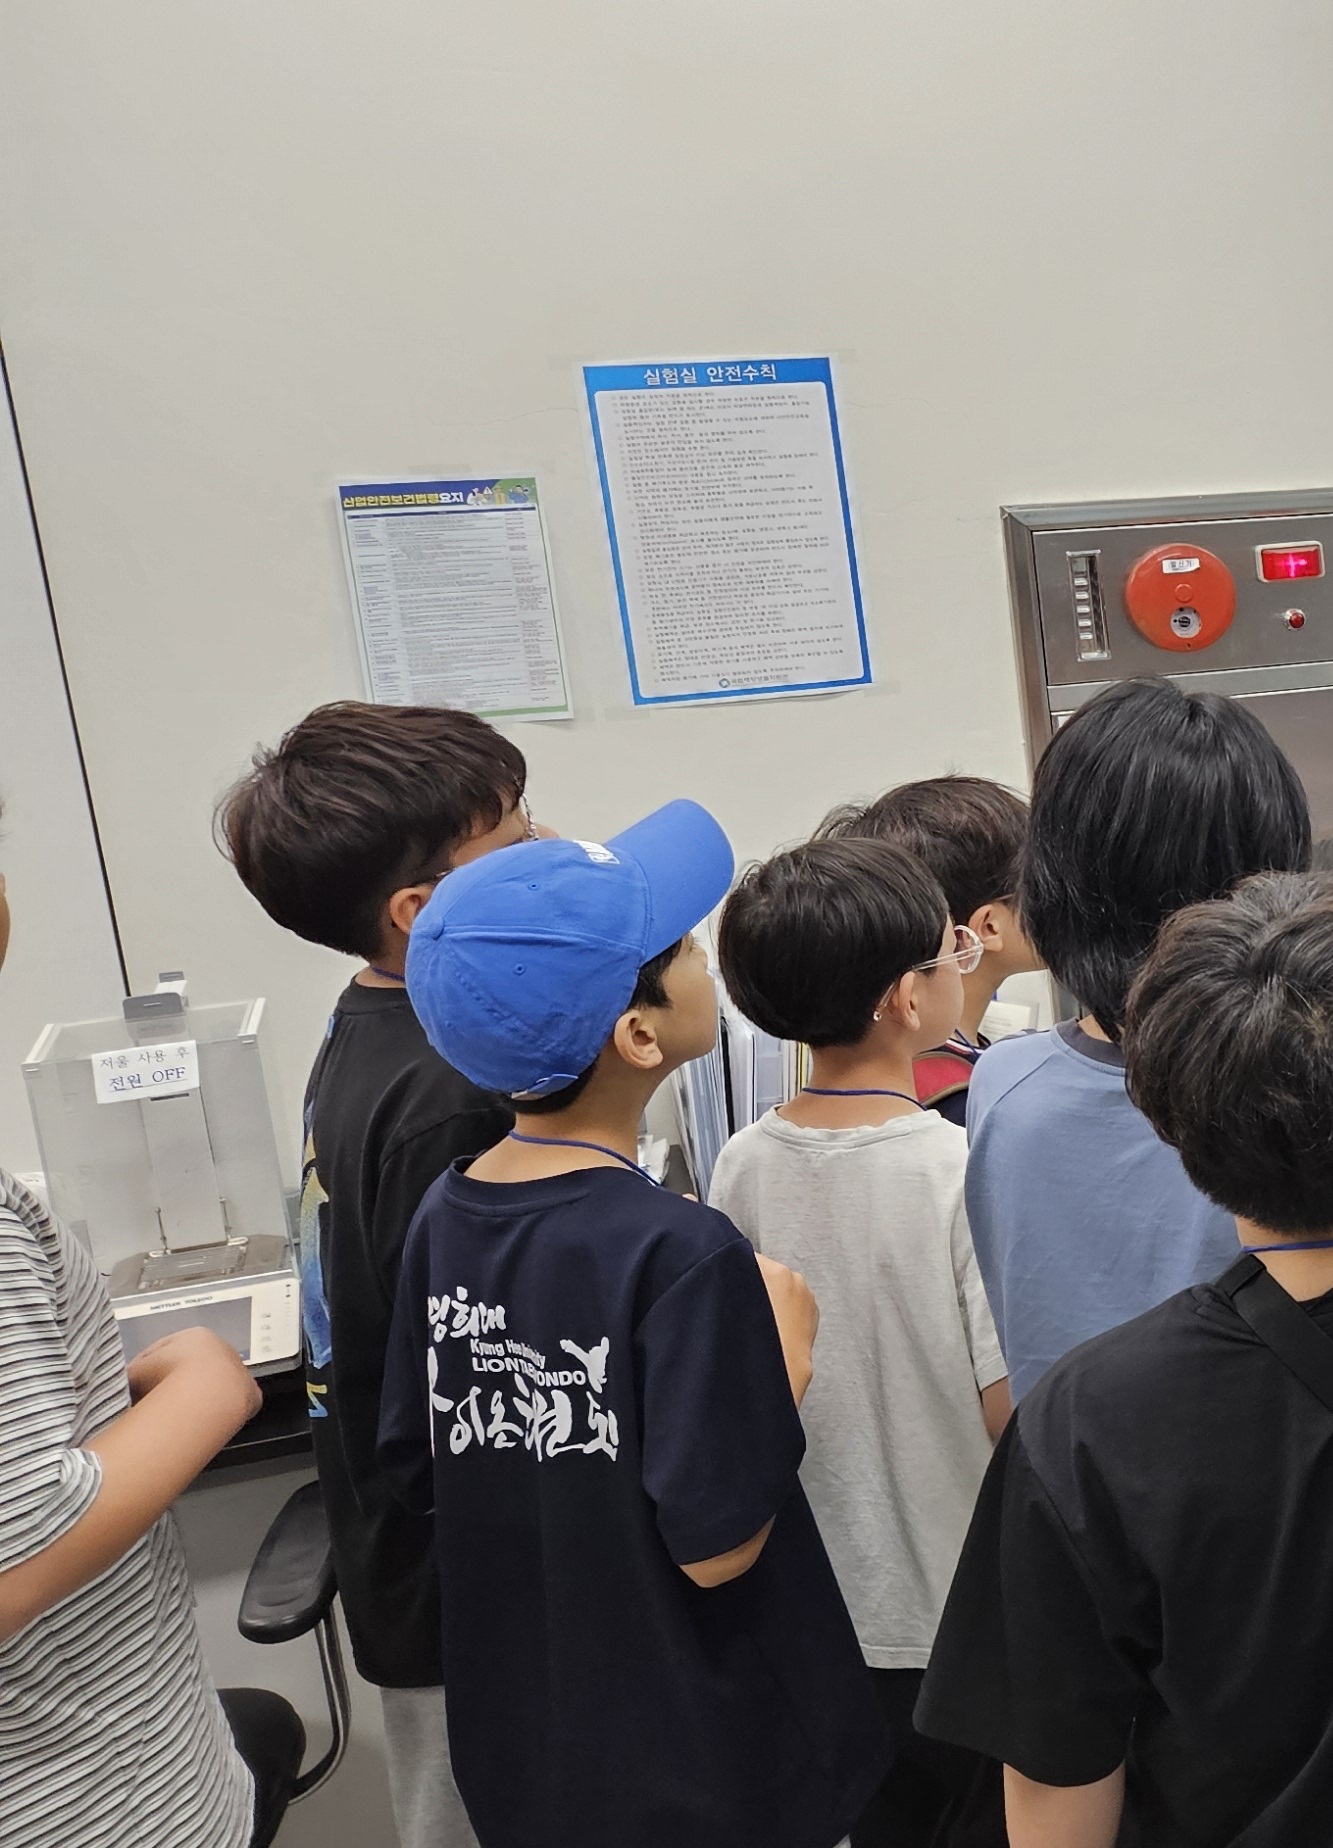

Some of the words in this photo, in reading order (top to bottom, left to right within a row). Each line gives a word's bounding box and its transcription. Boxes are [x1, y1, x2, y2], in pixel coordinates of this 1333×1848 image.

[644, 367, 697, 386] 실험실
[706, 364, 777, 383] 안전수칙
[100, 1055, 130, 1069] 저울
[138, 1050, 167, 1064] 사용
[109, 1074, 143, 1091] 전원
[152, 1067, 186, 1083] OFF
[184, 1296, 213, 1305] TOLEDO
[470, 1338, 505, 1356] Kyung
